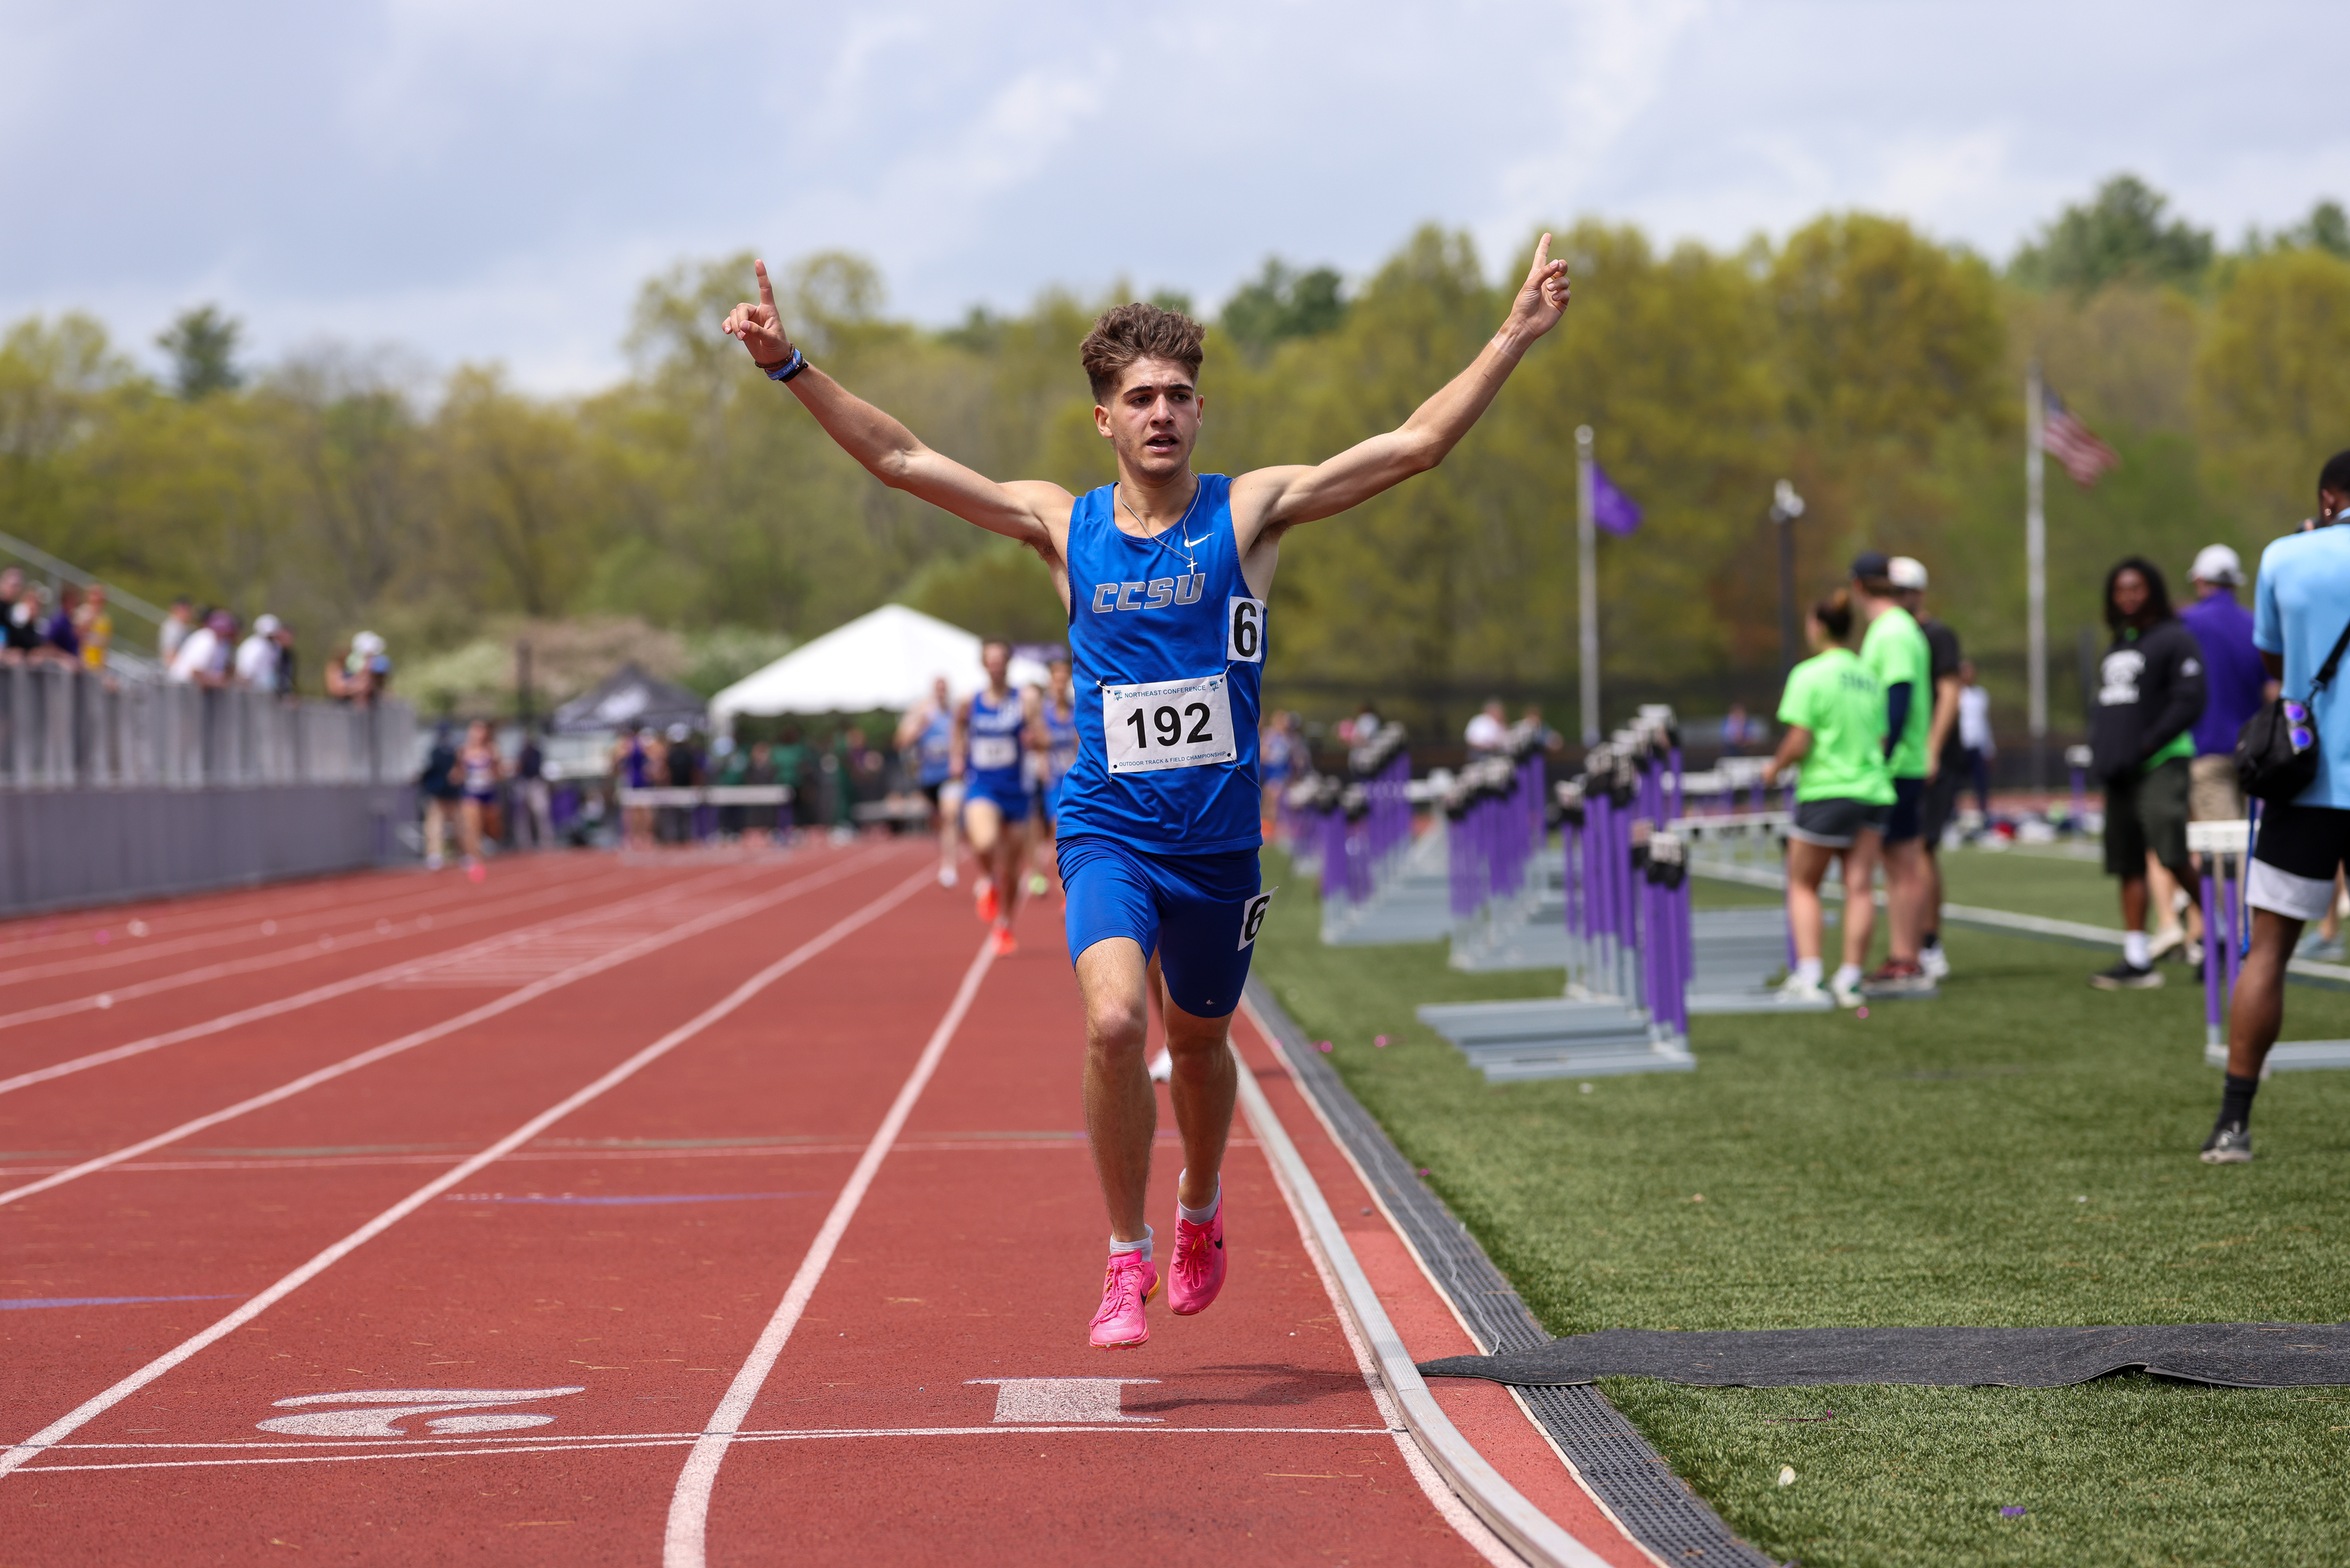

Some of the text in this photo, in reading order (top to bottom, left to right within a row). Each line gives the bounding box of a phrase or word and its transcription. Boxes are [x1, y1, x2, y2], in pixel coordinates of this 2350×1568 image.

[1092, 573, 1206, 614] CCSU
[1233, 601, 1258, 658] 6
[1124, 684, 1206, 699] NORTHEAST CONFERENCE
[1126, 702, 1213, 749] 192
[1186, 750, 1227, 761] CHAMPIONSHIP
[1244, 894, 1271, 942] 6
